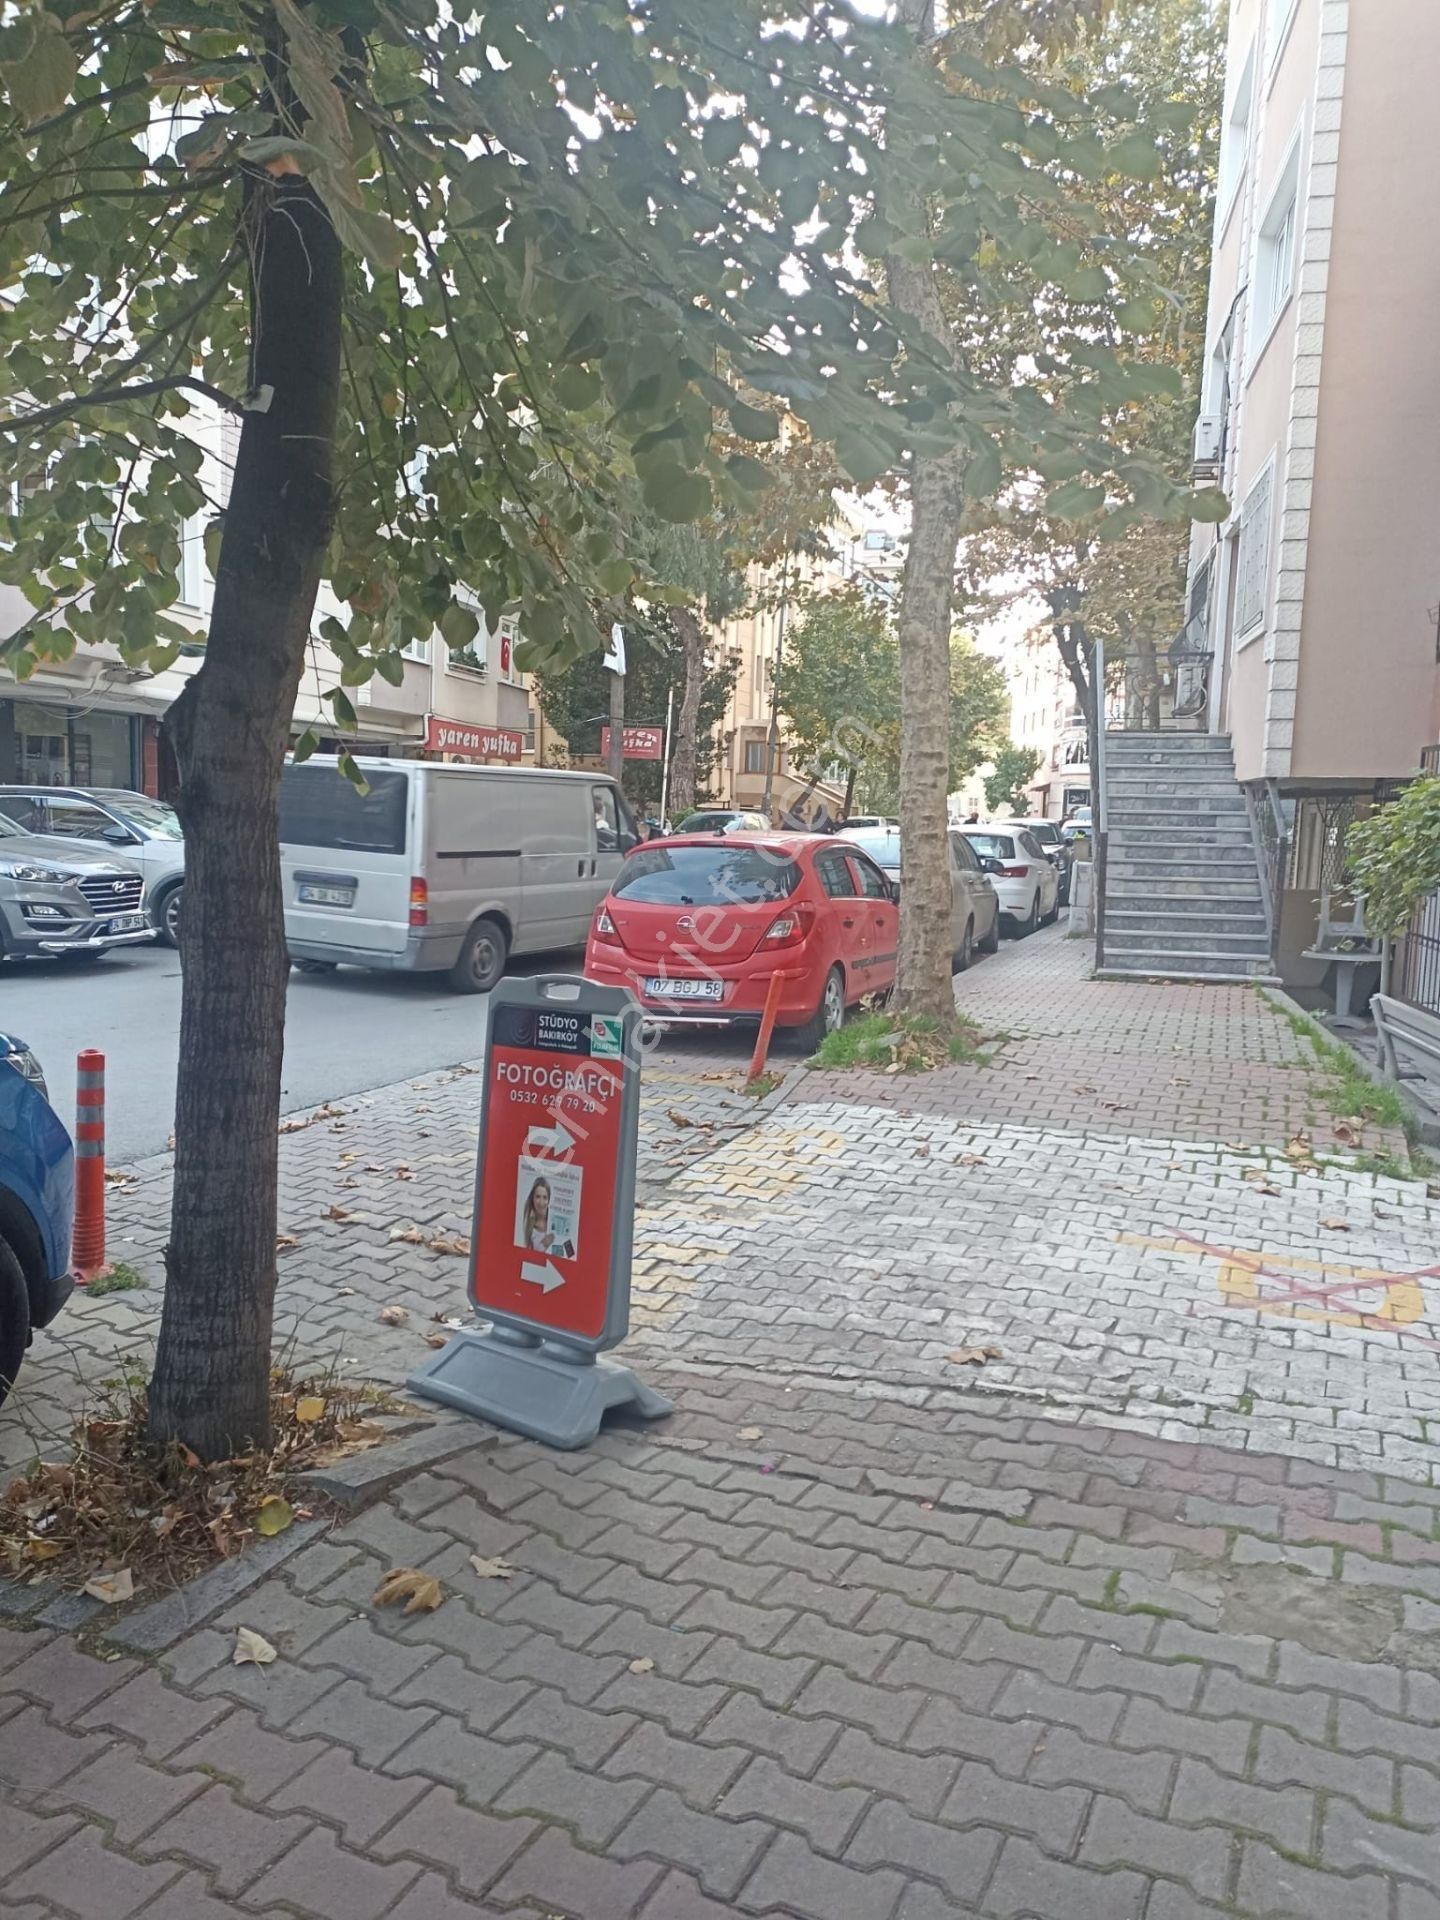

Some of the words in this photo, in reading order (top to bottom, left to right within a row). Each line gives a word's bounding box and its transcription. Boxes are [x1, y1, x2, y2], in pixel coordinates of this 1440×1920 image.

[438, 727, 479, 748] yaren
[482, 733, 517, 756] yufka
[653, 980, 669, 992] 07
[673, 980, 700, 994] BGJ
[705, 982, 721, 995] 58
[538, 1013, 578, 1030] STÜDYO
[537, 1029, 578, 1042] BAKIRKÖY
[496, 1062, 615, 1102] FOTOĞRAFÇI
[510, 1089, 538, 1104] 0532
[567, 1097, 579, 1109] 79
[583, 1099, 596, 1112] 20
